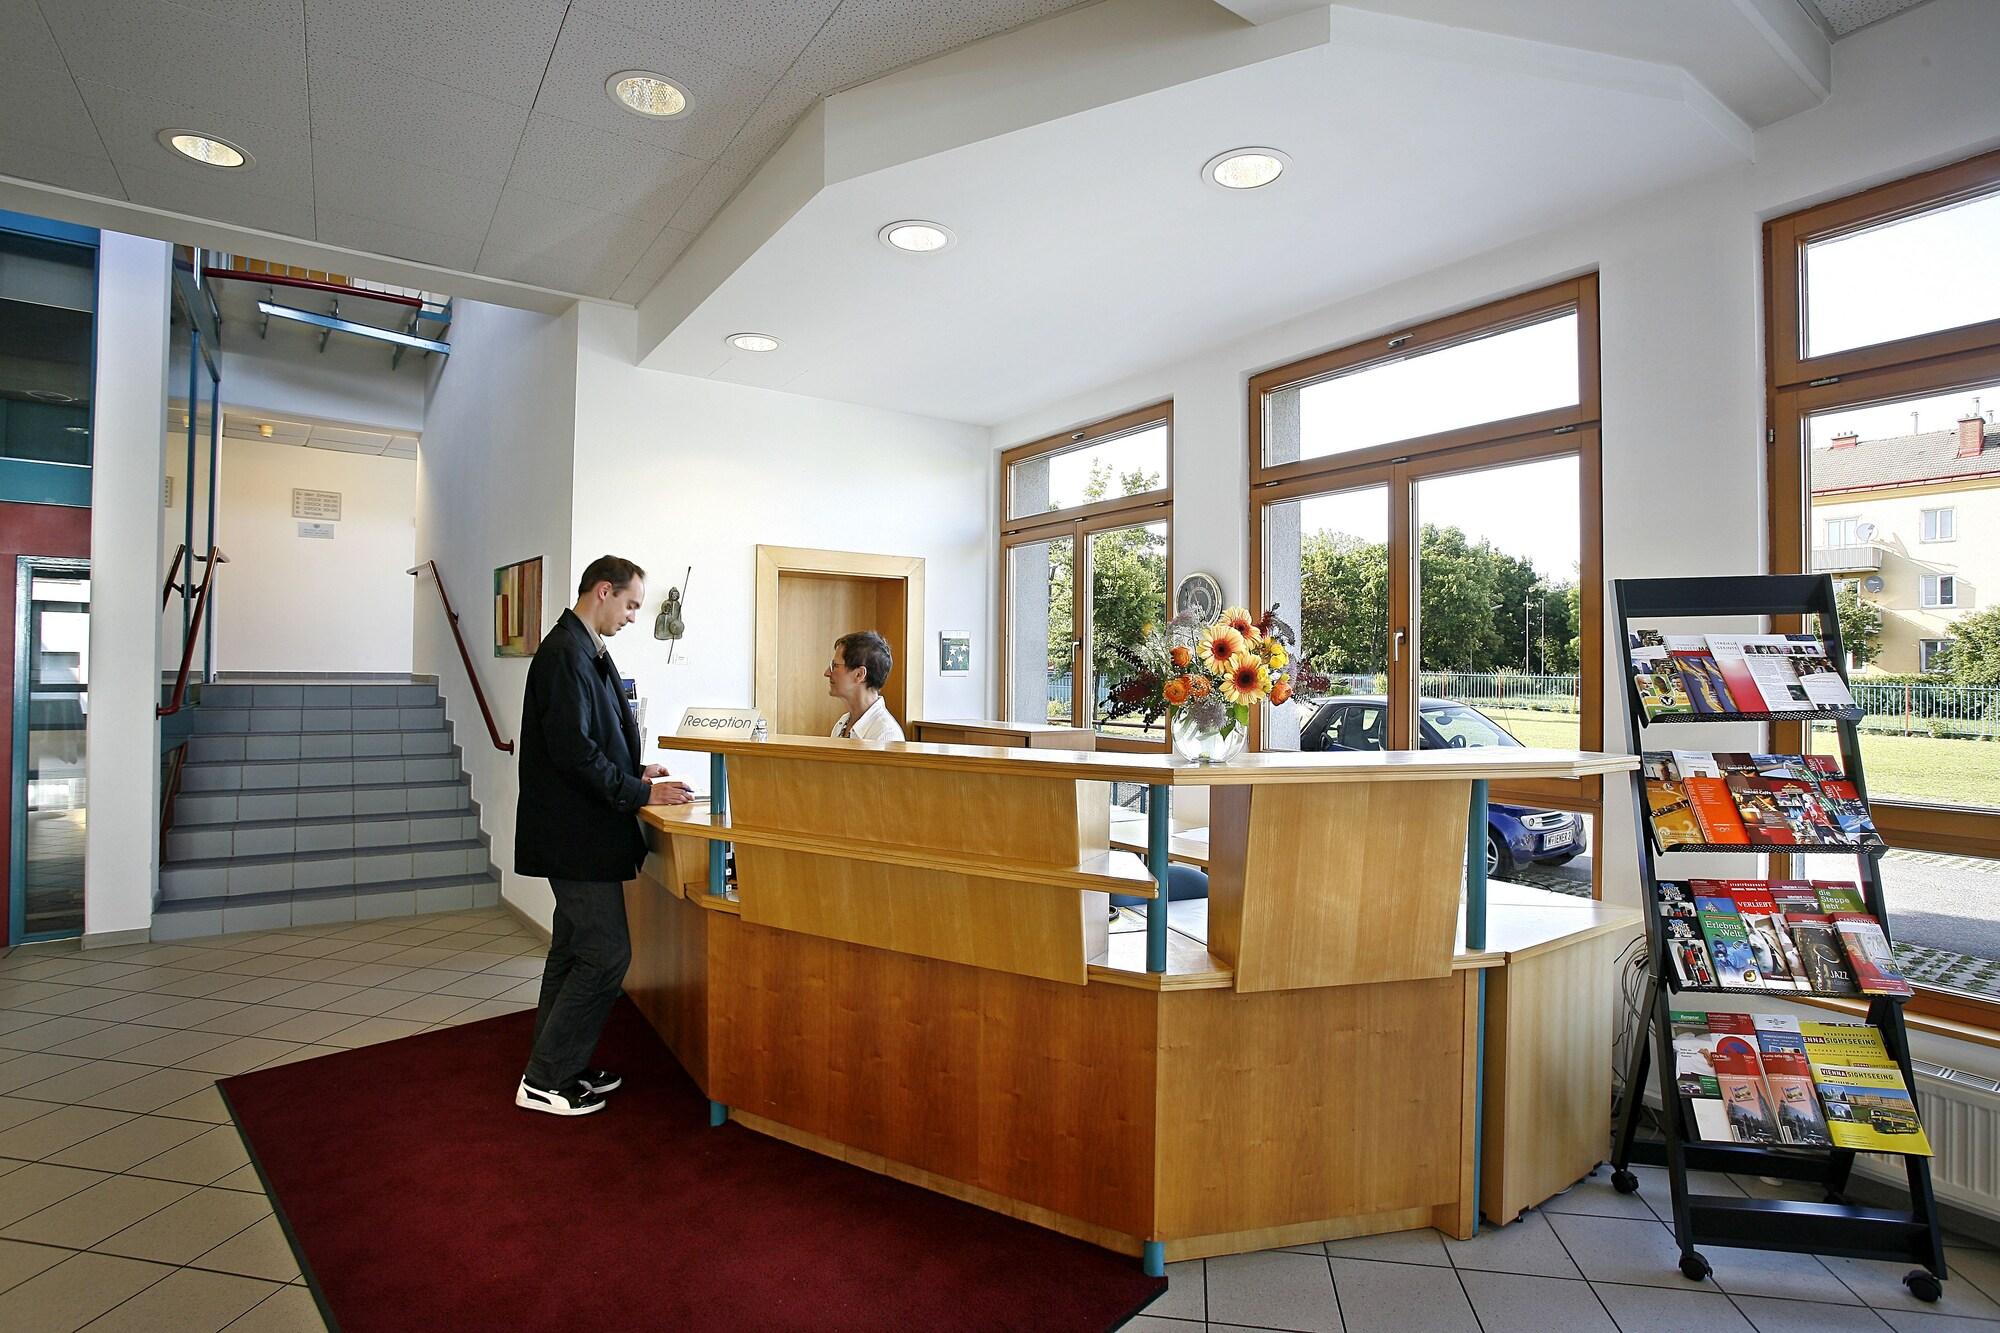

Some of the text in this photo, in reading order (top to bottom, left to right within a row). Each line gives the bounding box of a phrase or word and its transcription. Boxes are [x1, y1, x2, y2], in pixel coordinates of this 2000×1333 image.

[684, 715, 752, 730] Reception
[1820, 896, 1850, 904] Steppe
[1705, 920, 1742, 930] Erlebnis
[1830, 970, 1849, 980] JAZZ
[1803, 1036, 1824, 1044] ENNA
[1825, 1037, 1877, 1046] SIGHTSEEING
[1821, 1069, 1894, 1081] VIENNA SIGHTSEEING
